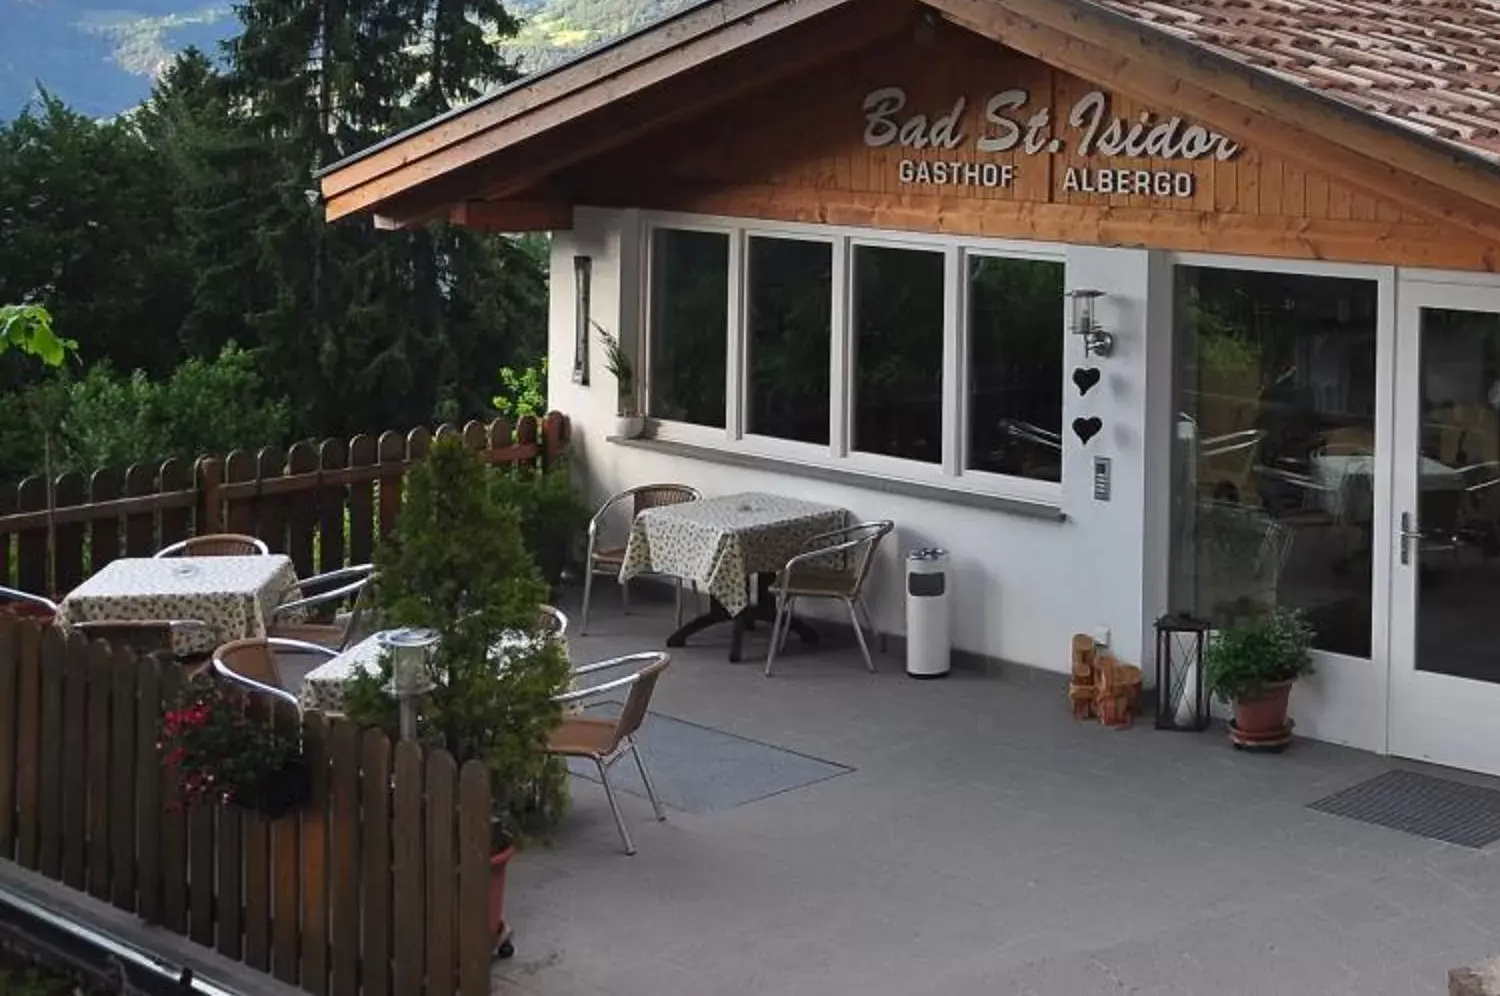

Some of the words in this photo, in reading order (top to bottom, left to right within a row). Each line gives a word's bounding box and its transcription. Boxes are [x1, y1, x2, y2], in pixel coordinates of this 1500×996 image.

[862, 86, 966, 149] Bad
[978, 89, 1064, 156] St.
[1070, 91, 1242, 161] Isidor
[898, 160, 1015, 188] GASTHOF
[1063, 166, 1194, 197] ALBERGO
